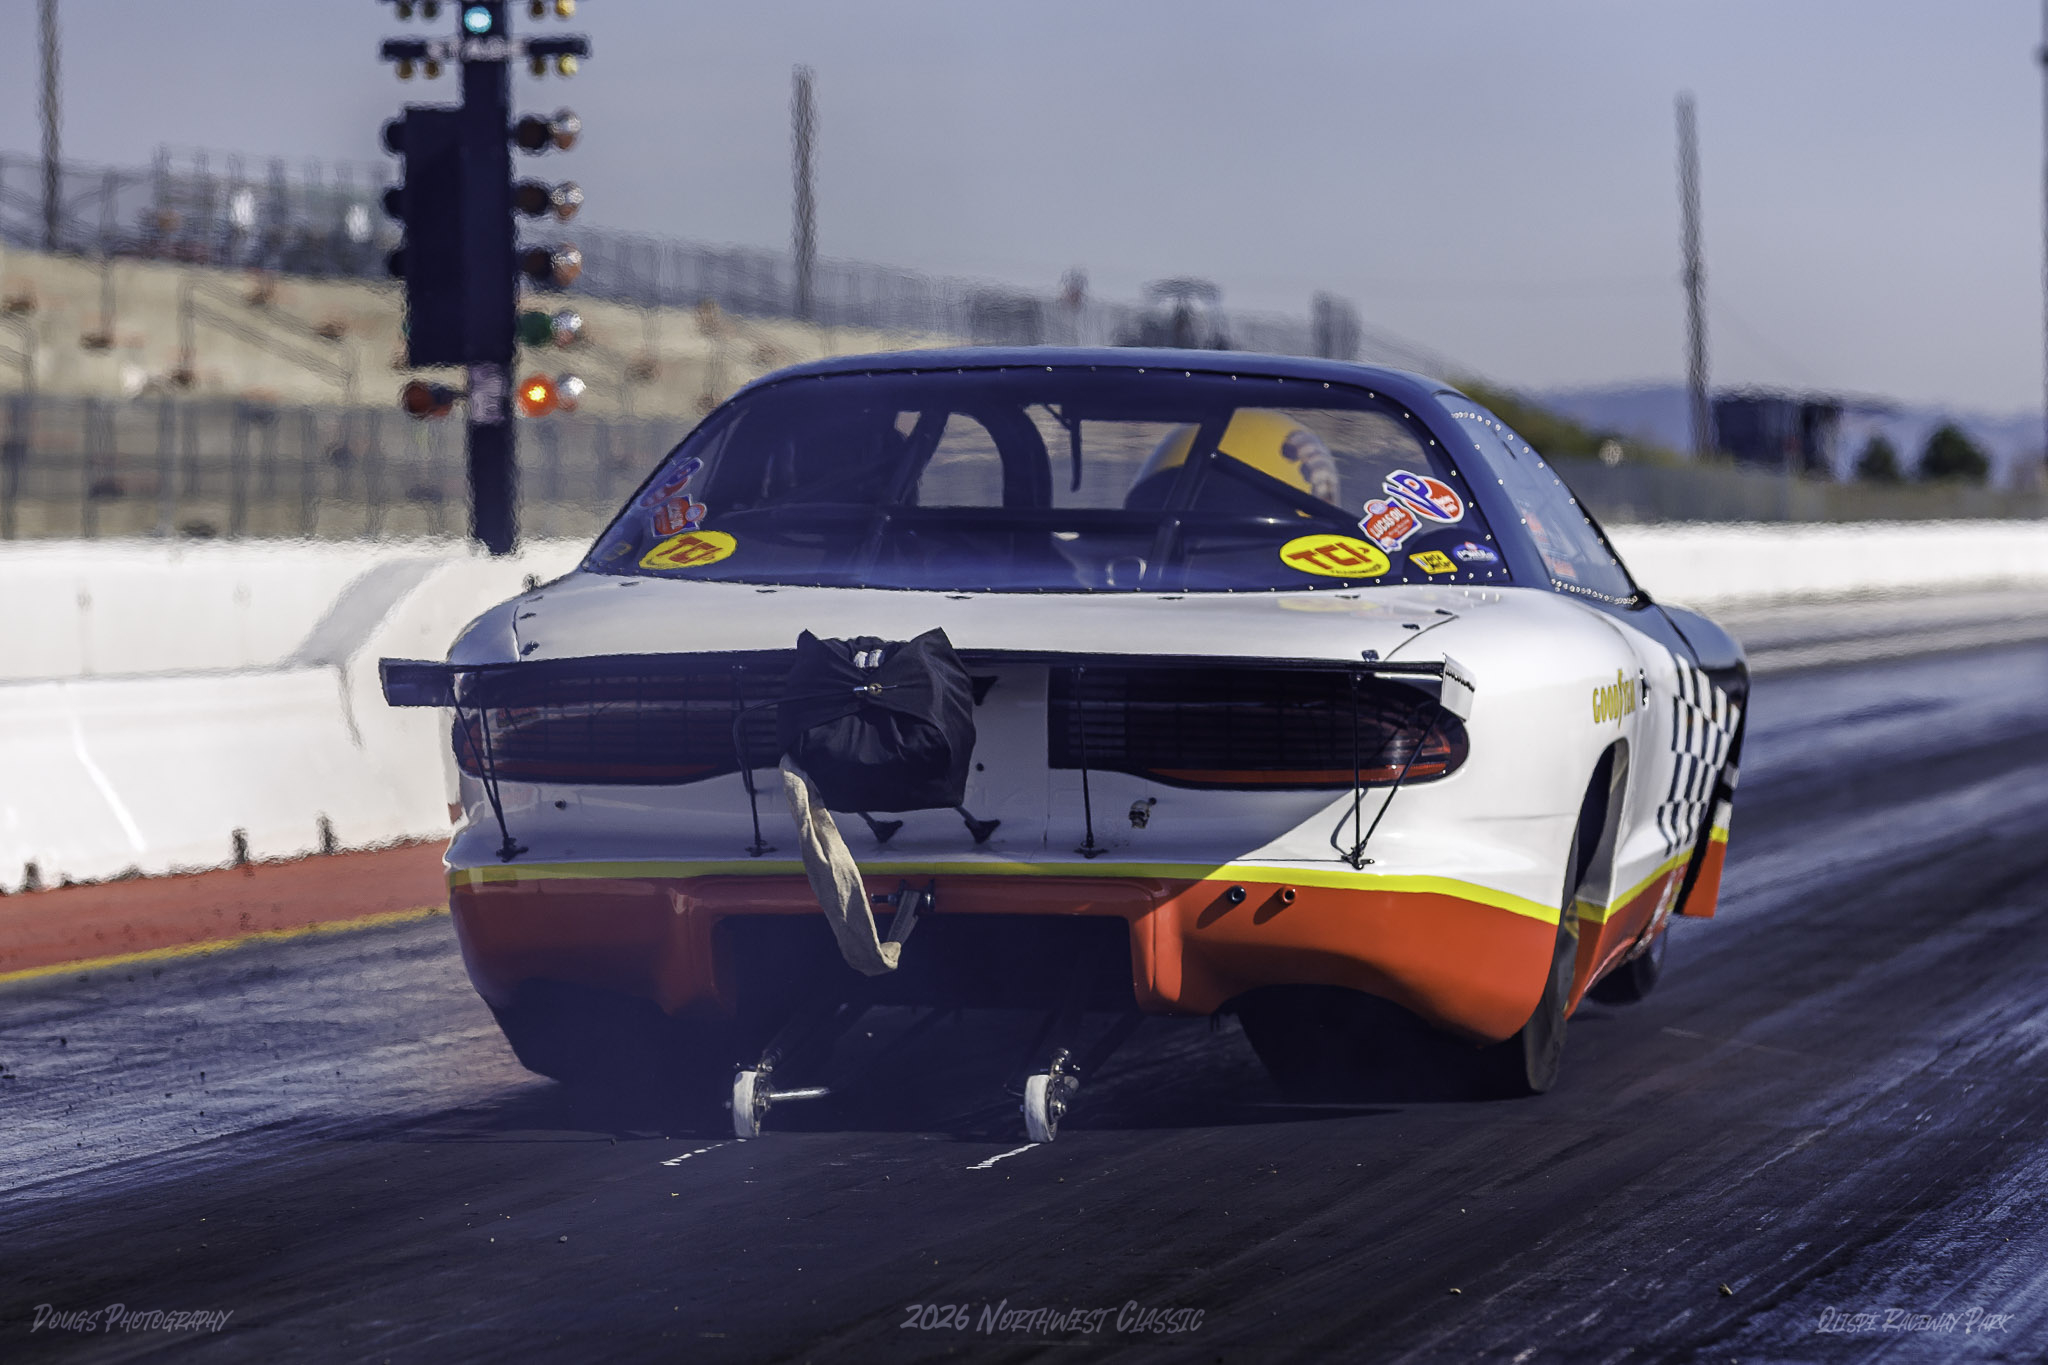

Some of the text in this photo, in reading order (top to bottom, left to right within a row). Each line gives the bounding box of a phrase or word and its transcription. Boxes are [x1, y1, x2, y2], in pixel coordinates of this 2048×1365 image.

[1368, 512, 1396, 538] LUCAS
[1389, 507, 1406, 520] OIL
[1287, 542, 1372, 570] TCI
[1592, 668, 1636, 729] GOODYEAR
